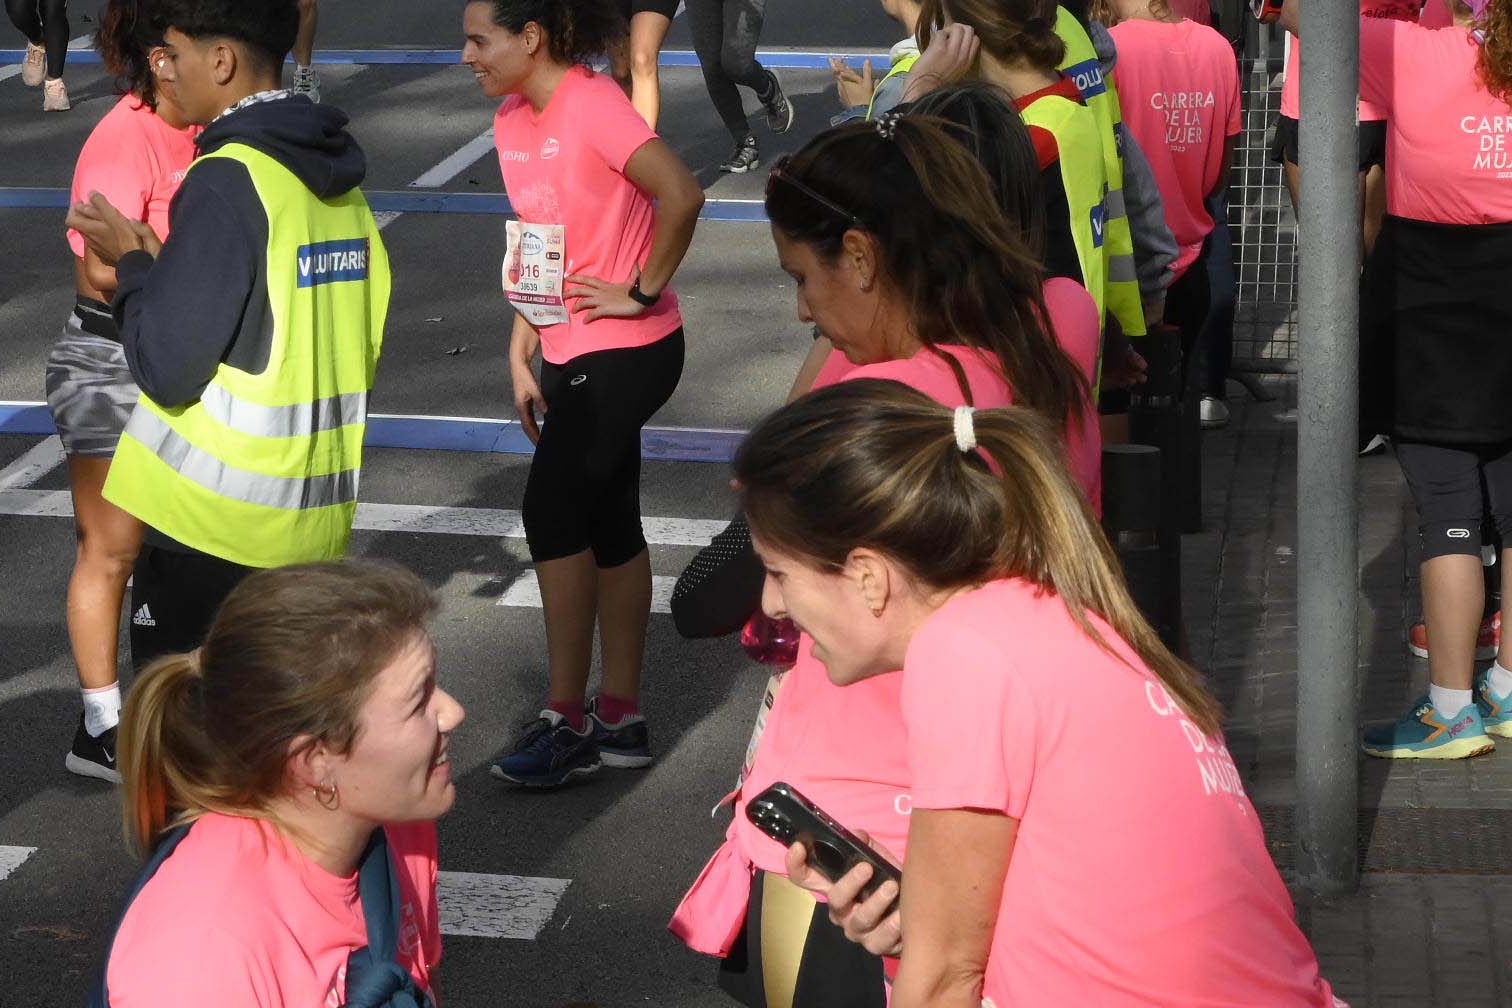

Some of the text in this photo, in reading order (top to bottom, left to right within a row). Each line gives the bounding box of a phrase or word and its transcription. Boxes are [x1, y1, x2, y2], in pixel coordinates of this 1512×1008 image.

[1150, 91, 1215, 110] CARRERA
[1184, 110, 1201, 126] LA
[1460, 115, 1512, 134] CARR
[1480, 134, 1505, 152] DE
